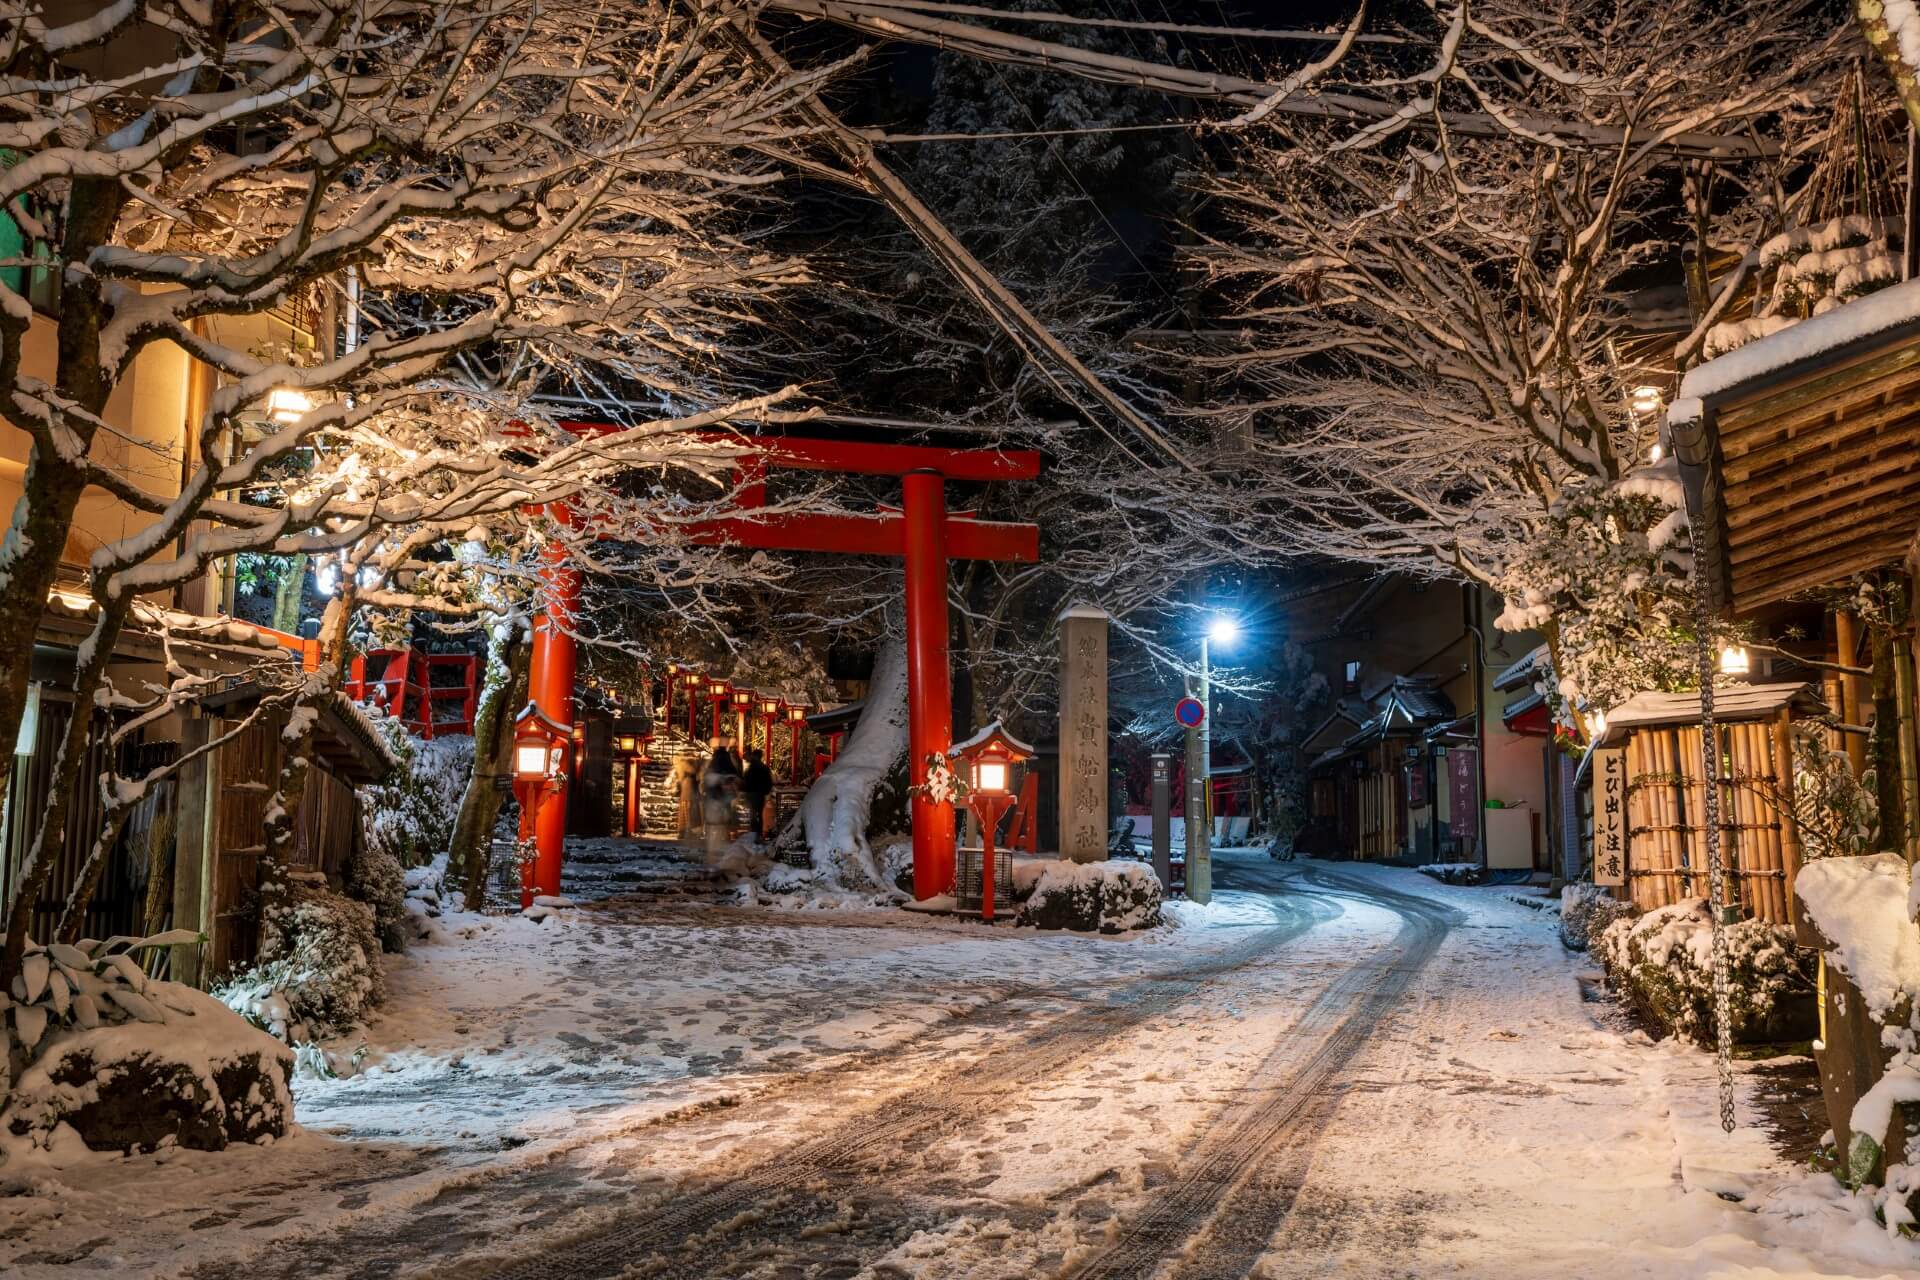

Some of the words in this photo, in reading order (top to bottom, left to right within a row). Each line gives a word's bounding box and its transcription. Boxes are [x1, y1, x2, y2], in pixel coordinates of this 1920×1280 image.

[1596, 824, 1605, 877] ふじや
[1605, 756, 1621, 877] とび出し注意
